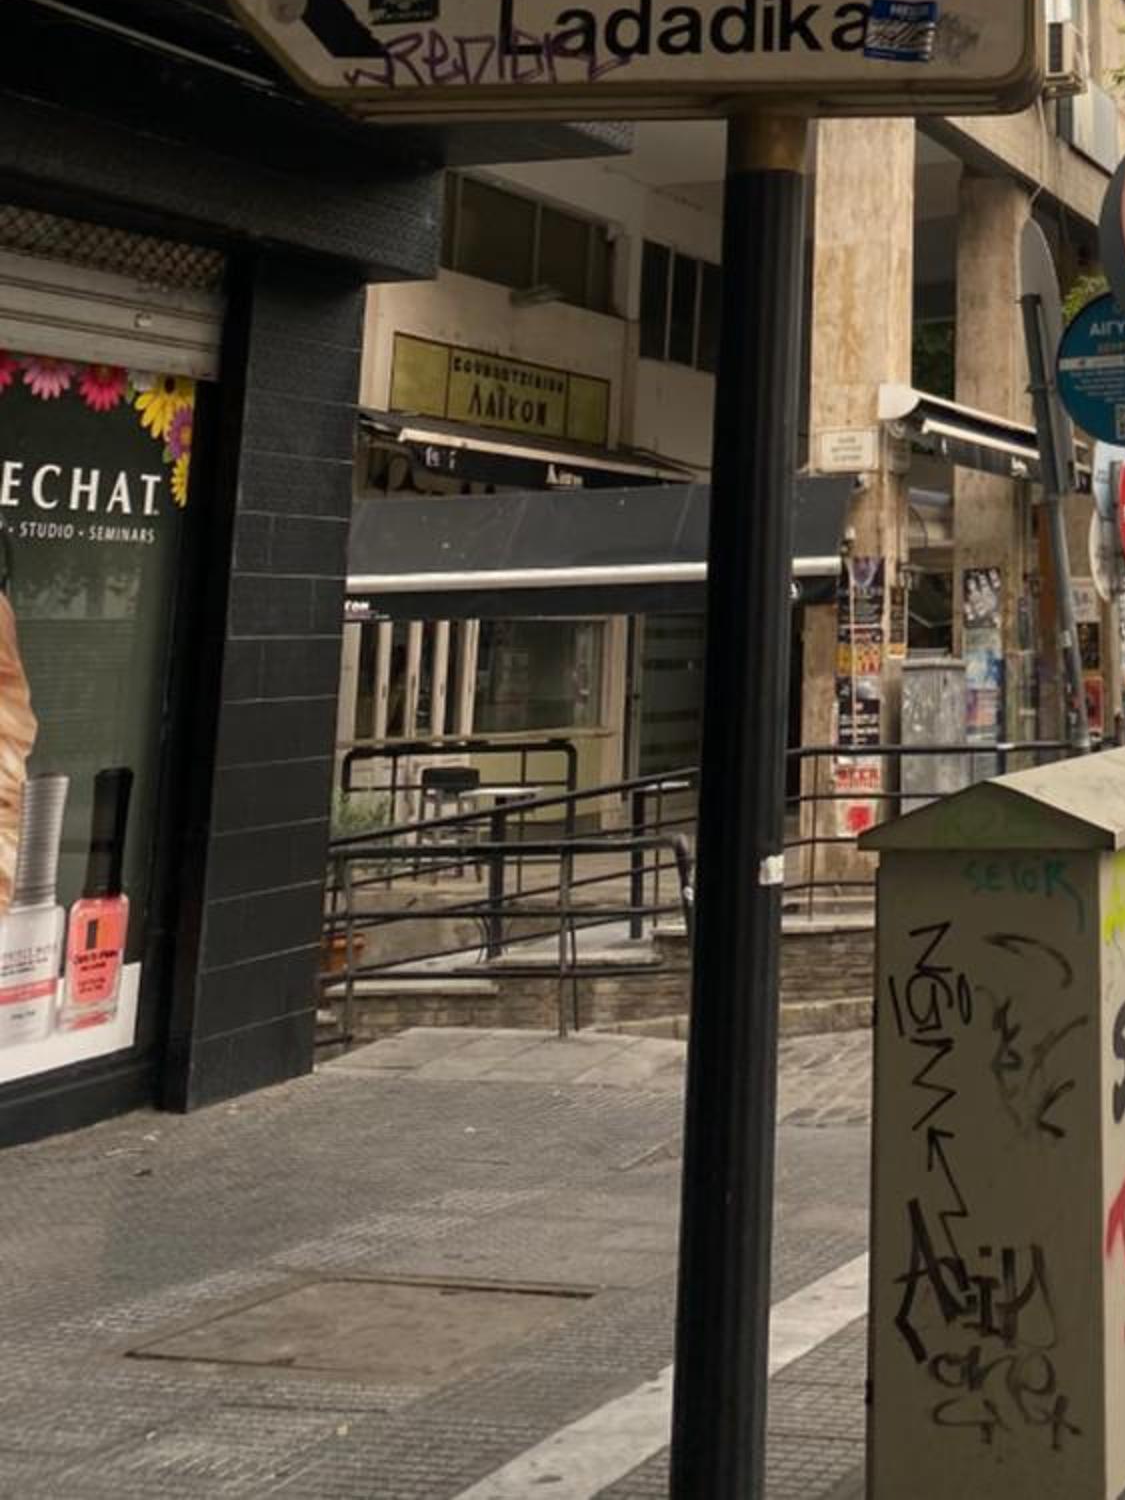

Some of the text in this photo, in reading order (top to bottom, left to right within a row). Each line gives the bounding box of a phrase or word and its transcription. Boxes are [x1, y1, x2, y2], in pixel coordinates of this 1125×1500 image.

[1, 460, 162, 515] ECHAT
[19, 521, 155, 544] STUDIO SEMINARS
